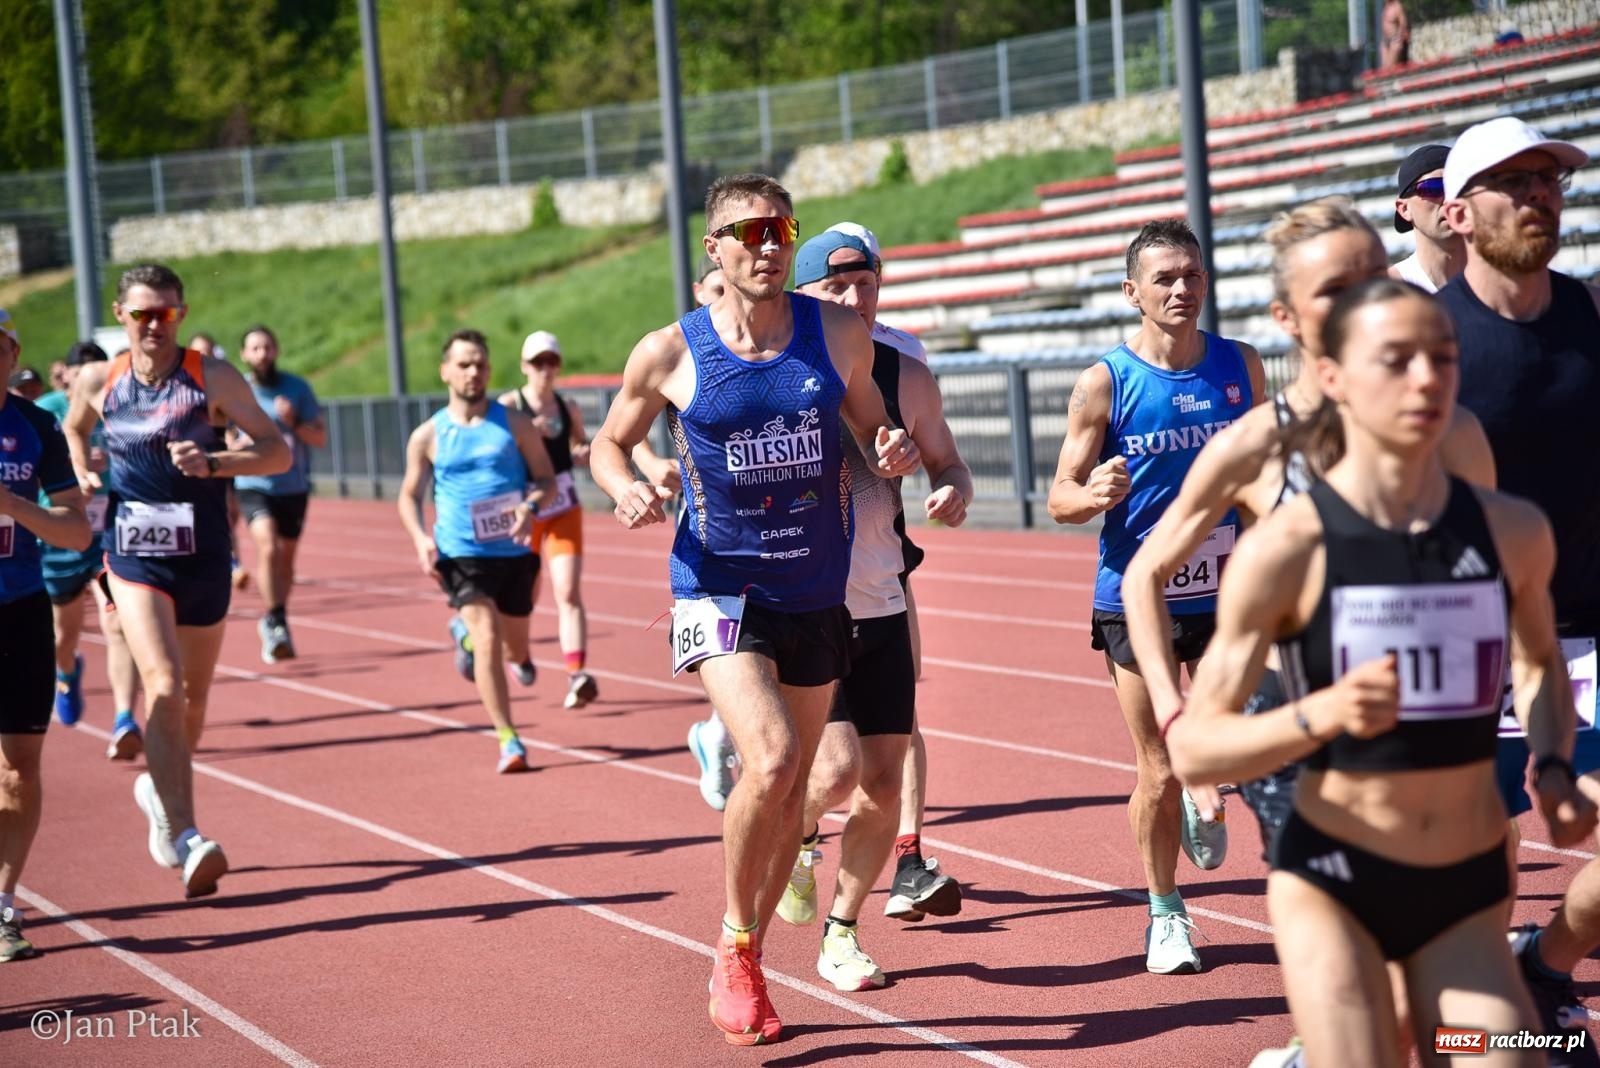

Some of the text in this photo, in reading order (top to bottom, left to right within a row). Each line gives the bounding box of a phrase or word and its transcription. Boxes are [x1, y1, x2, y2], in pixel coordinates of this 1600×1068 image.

[728, 432, 820, 468] SILESIAN
[0, 462, 34, 480] RS
[732, 462, 822, 487] TRIATHLON TEAM
[128, 526, 172, 545] 242
[760, 526, 805, 540] CAPEK
[1164, 560, 1210, 588] 84
[677, 622, 706, 658] 186
